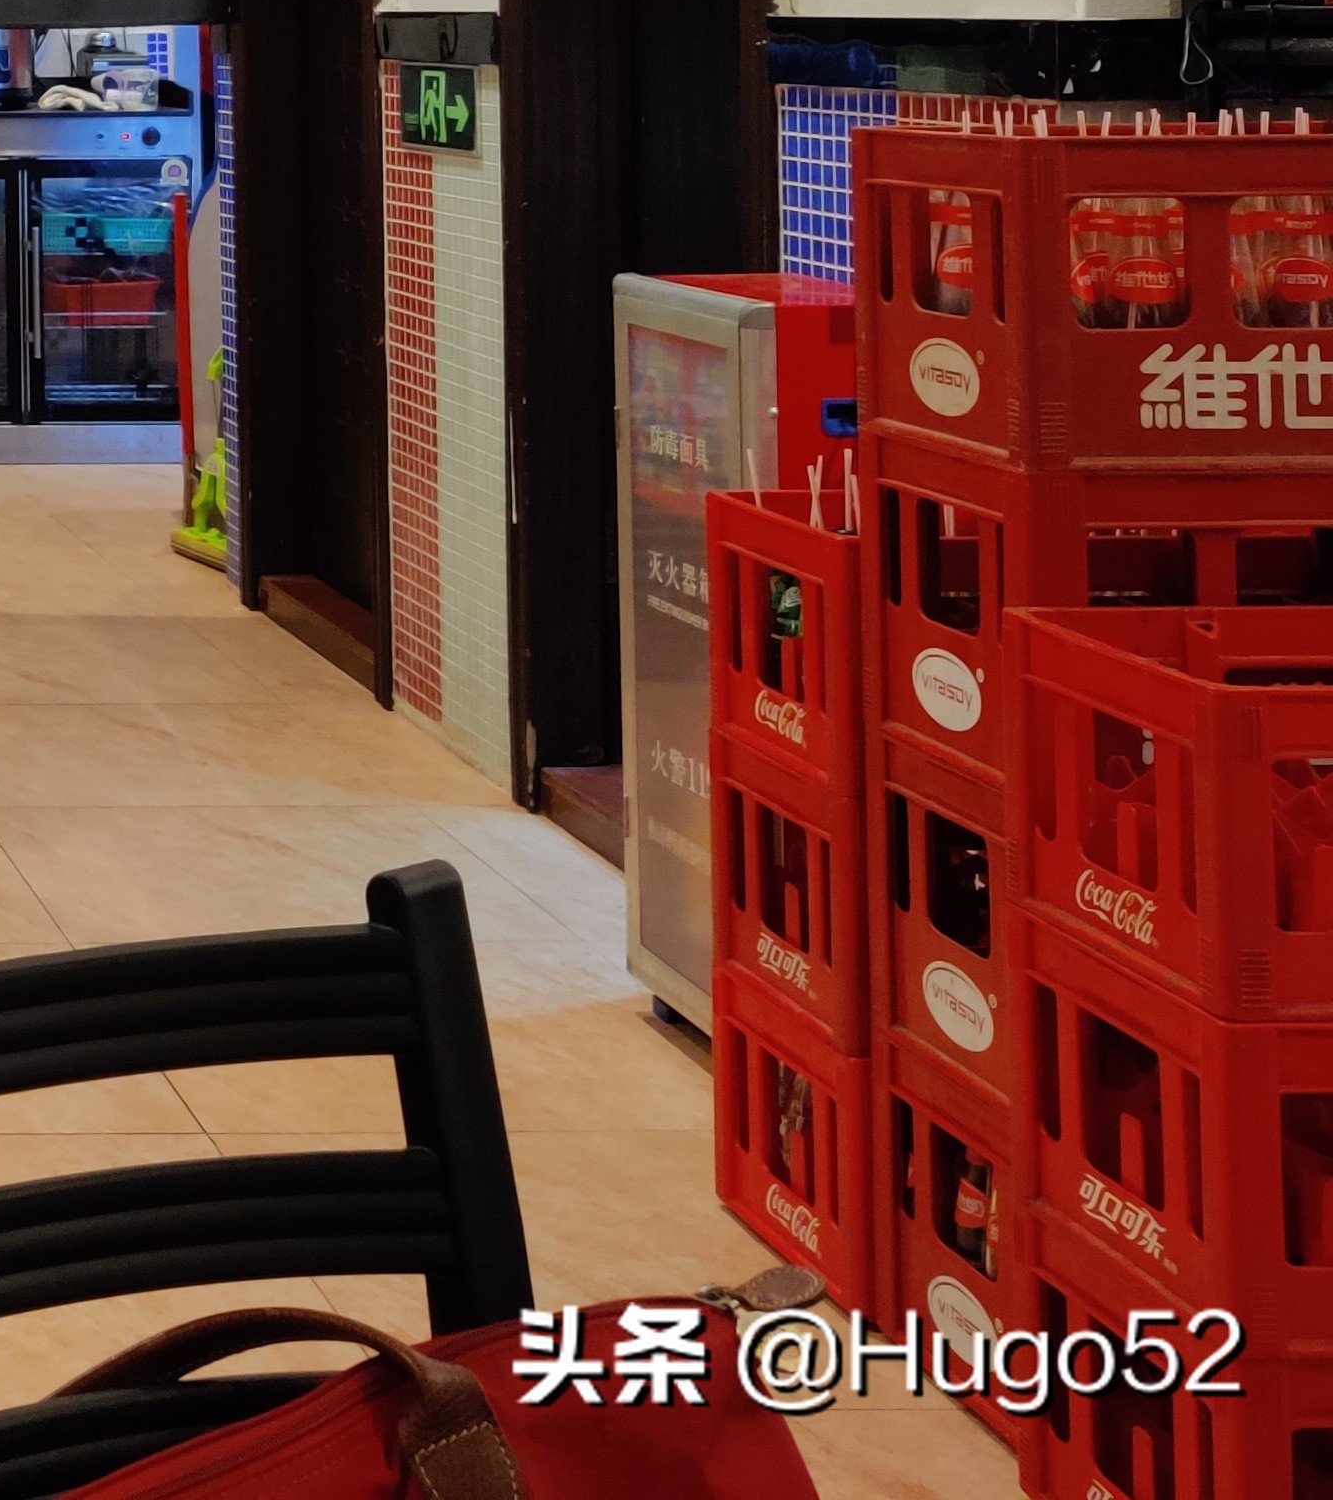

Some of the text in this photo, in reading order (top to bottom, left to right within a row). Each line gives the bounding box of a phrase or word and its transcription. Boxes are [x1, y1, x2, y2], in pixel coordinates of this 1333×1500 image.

[650, 425, 710, 472] 防毒面具
[651, 739, 711, 799] 火警11
[1075, 869, 1158, 945] Coca-Cola
[757, 932, 811, 992] 可口可乐
[1079, 1172, 1167, 1260] 可口可乐
